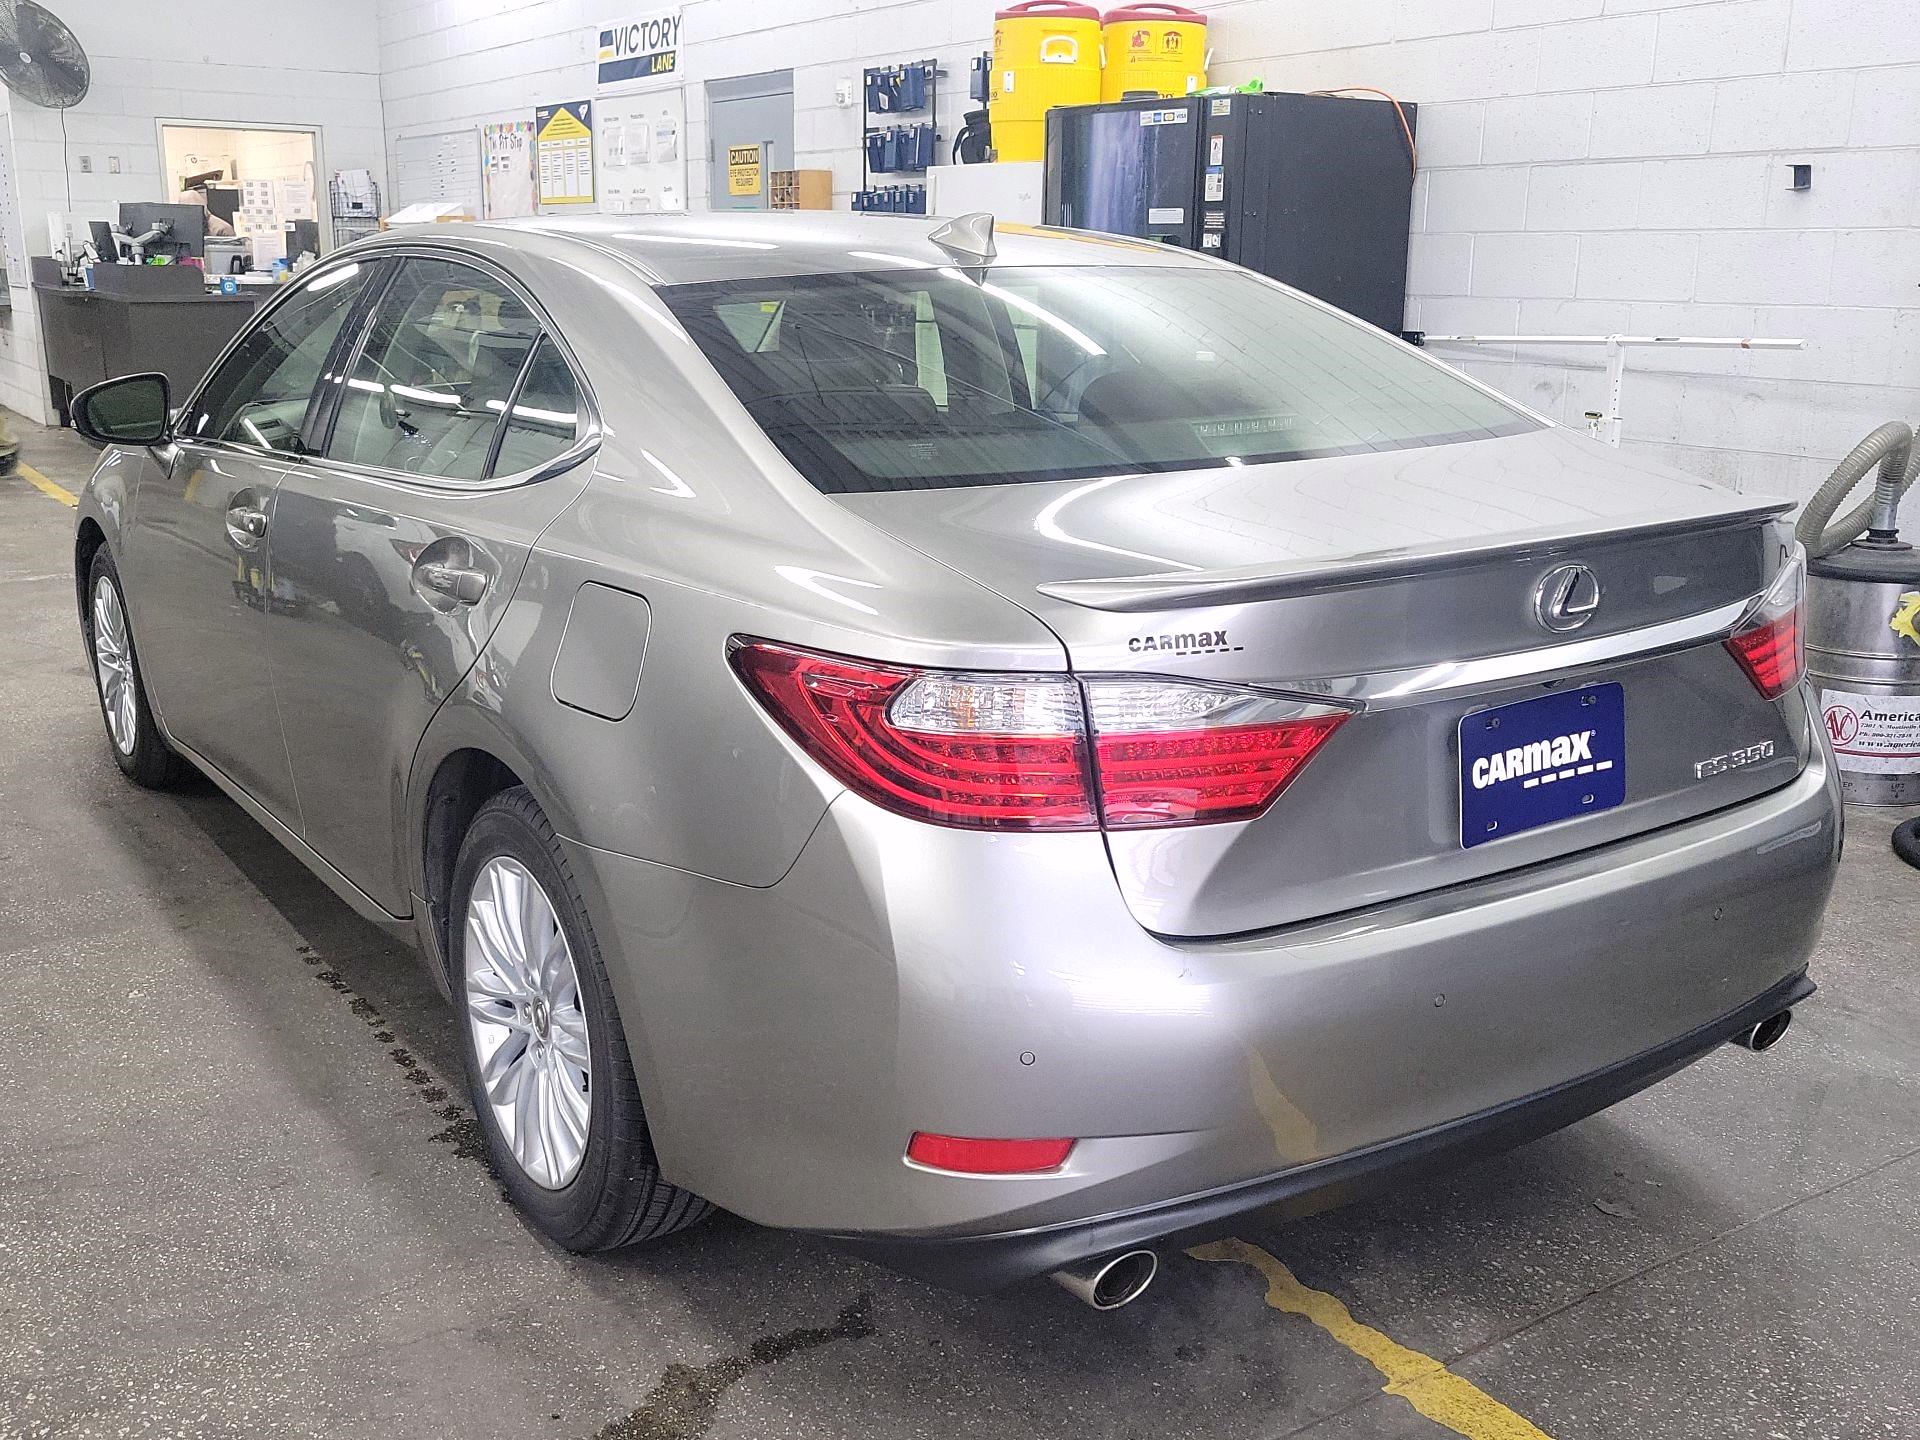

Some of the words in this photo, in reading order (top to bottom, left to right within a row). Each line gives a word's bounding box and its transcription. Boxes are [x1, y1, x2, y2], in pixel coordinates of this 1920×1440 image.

[615, 14, 682, 56] VICTORY
[651, 53, 675, 73] LANE
[730, 150, 759, 164] CAUTION
[1128, 630, 1228, 652] CARmax
